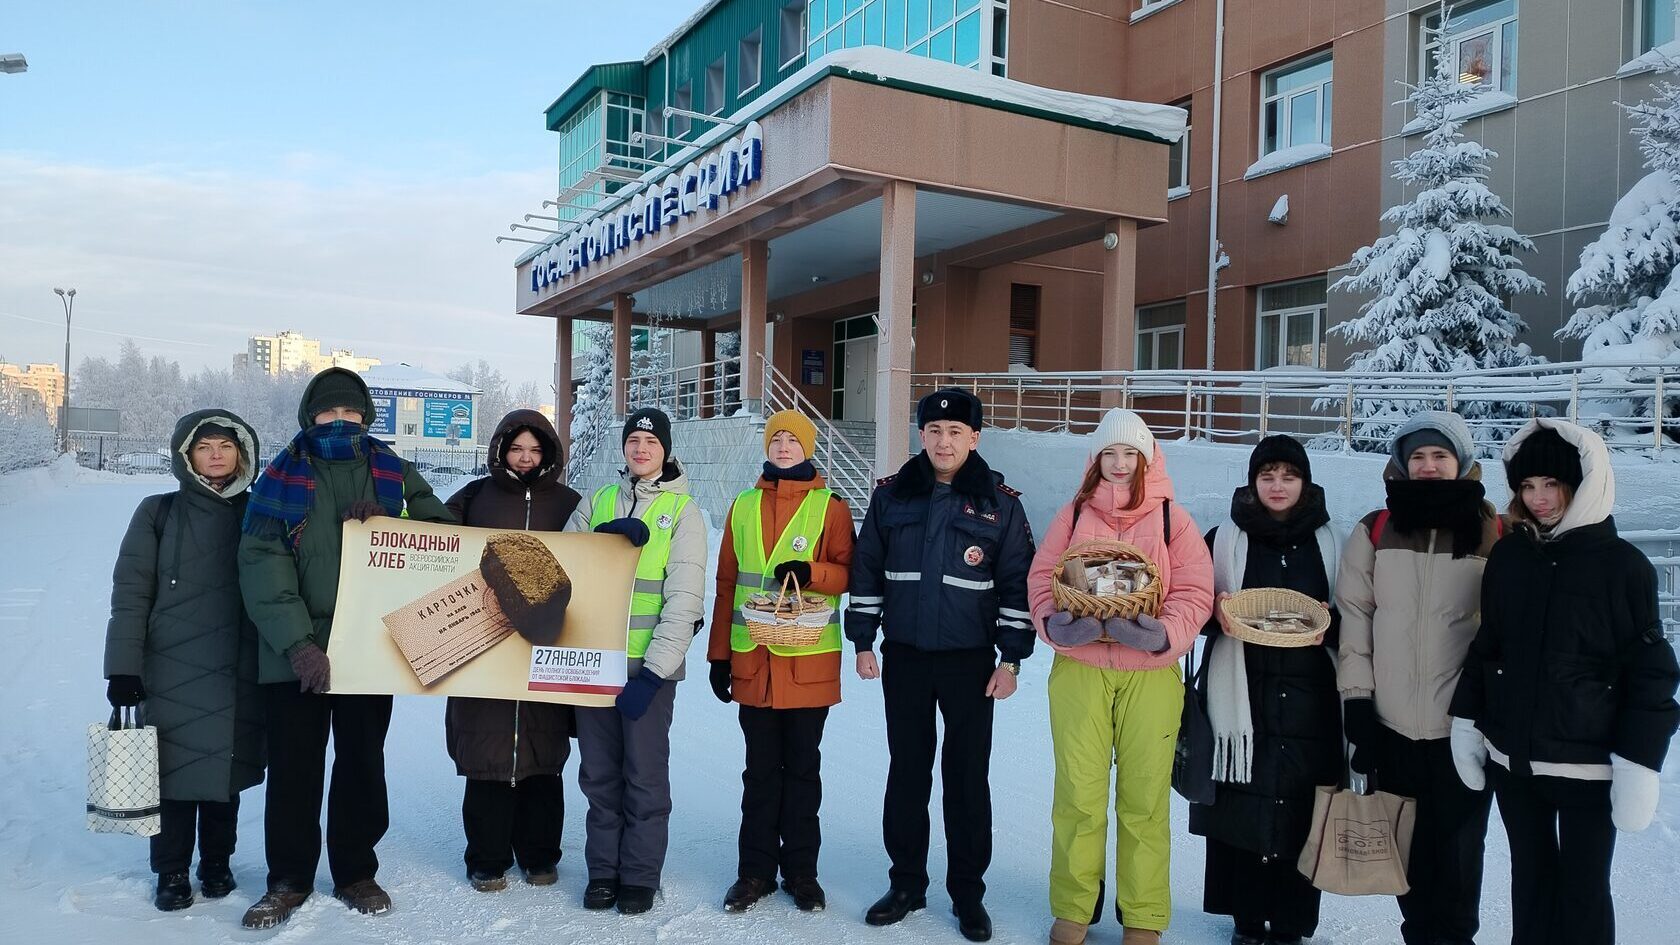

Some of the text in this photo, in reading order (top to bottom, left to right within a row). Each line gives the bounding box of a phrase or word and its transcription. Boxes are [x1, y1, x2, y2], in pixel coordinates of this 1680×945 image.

[530, 130, 763, 293] ГОСАВТОИНСПЕКЦИЯ
[369, 389, 412, 397] ОТОВЛЕНИЕ
[415, 390, 462, 400] ГОСНОМЕРОВ
[370, 530, 460, 553] БЛОКАДНЫЙ
[367, 551, 406, 569] ХЛЕБ
[409, 553, 459, 565] ВСЕРОССИЙСКАЯ
[408, 563, 456, 573] АКЦИЯ ПАМЯТИ
[417, 582, 479, 620] КАРТОЧКА
[447, 615, 470, 629] ЯНВАРЬ
